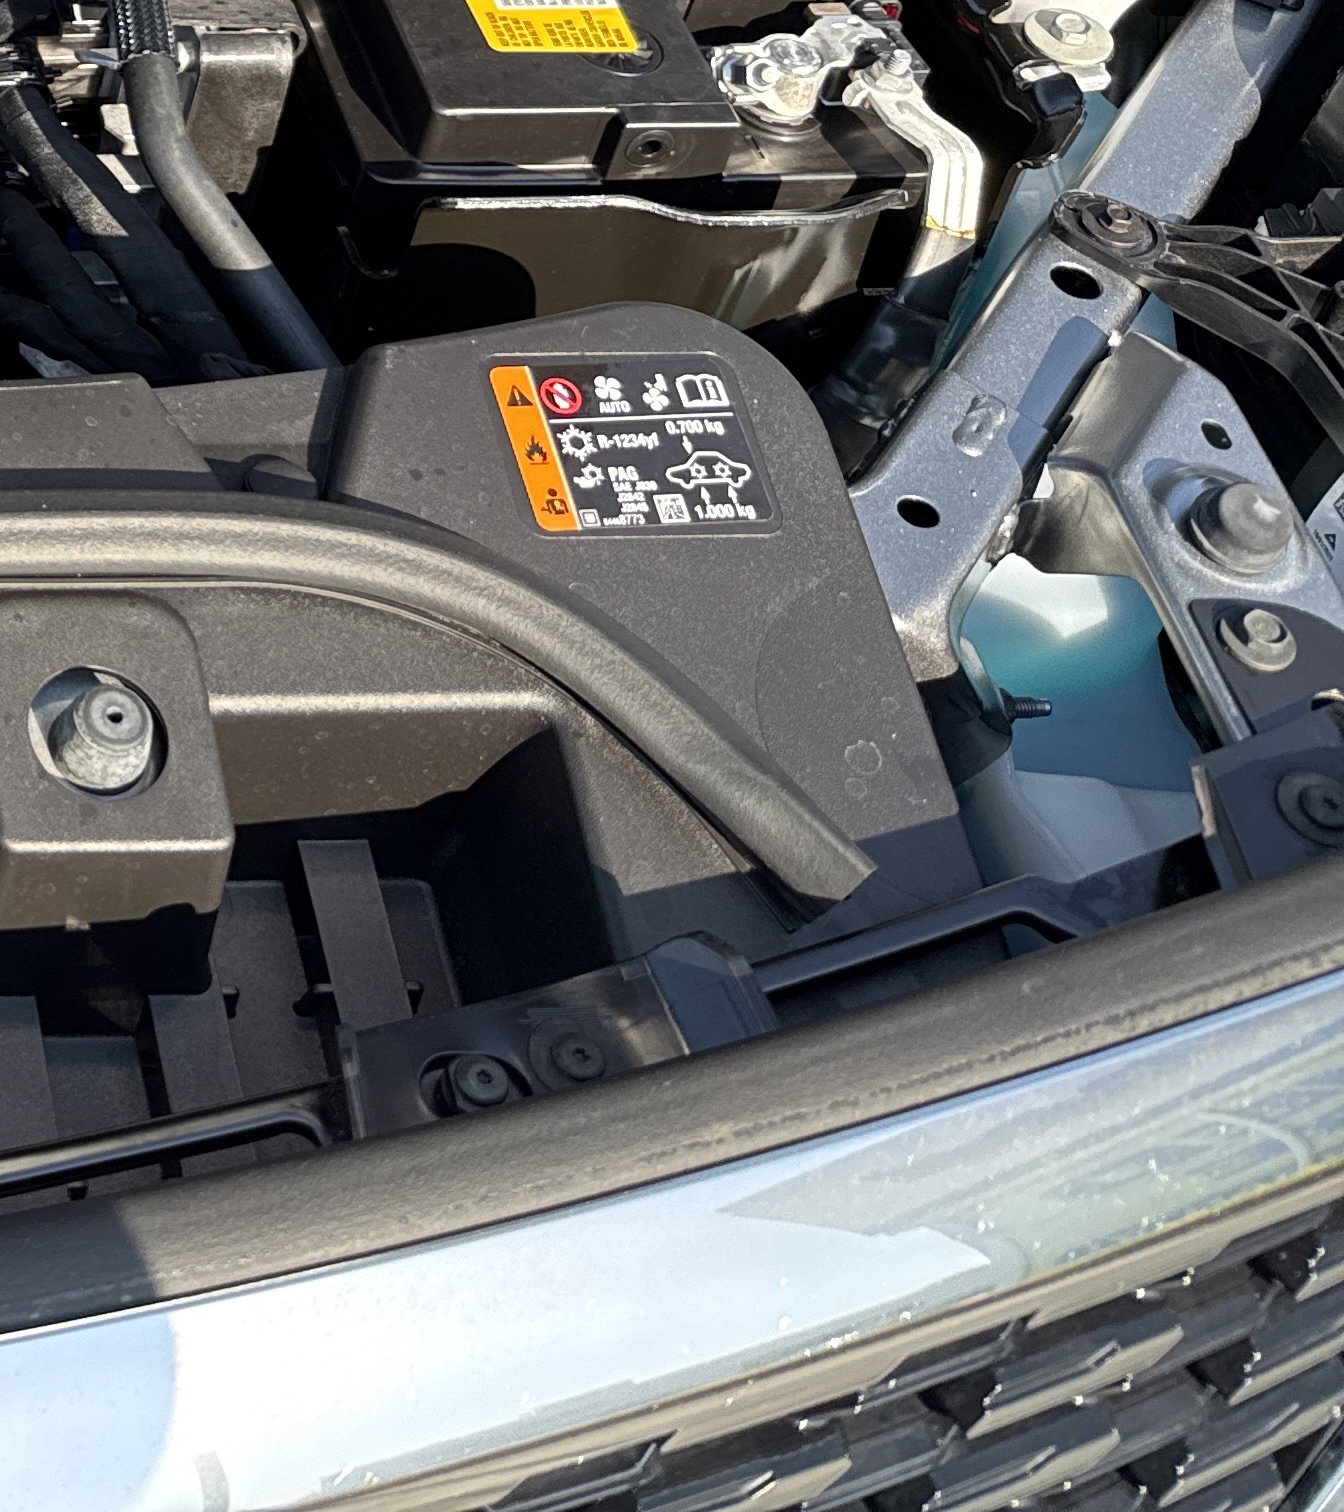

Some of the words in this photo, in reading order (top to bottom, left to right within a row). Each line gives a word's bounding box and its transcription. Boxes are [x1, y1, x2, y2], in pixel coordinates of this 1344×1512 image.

[599, 400, 632, 414] AUTO
[665, 420, 704, 435] 0.700
[704, 419, 725, 435] kg
[607, 466, 640, 481] PAG
[694, 504, 735, 519] 1.000
[736, 503, 757, 520] kg
